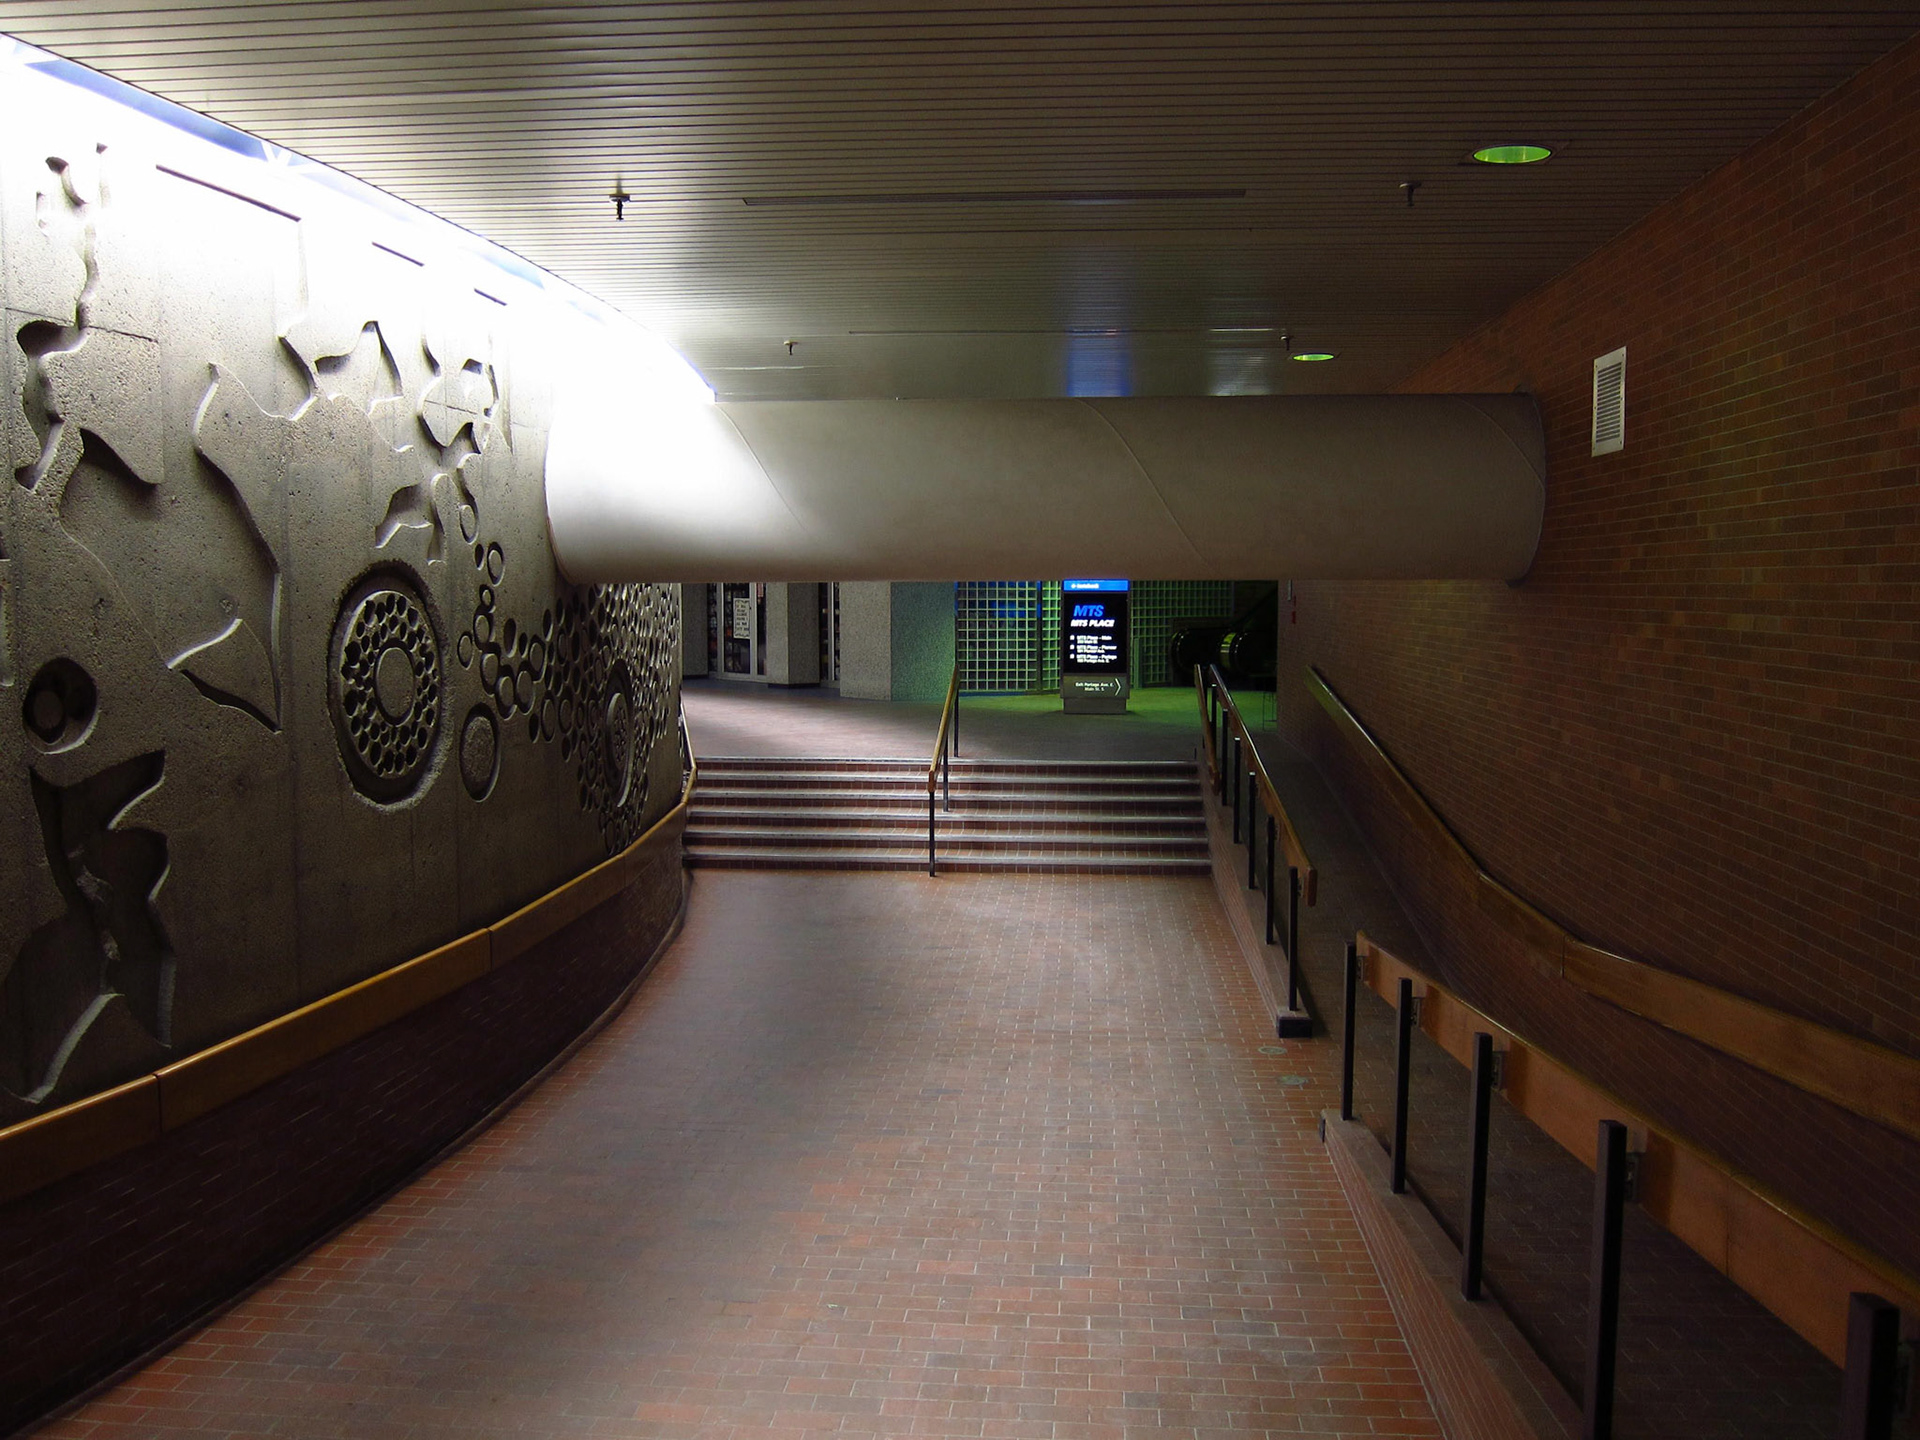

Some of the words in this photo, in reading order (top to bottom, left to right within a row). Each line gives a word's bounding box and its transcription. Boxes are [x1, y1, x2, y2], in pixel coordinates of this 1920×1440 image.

[1074, 605, 1105, 617] MTS
[1070, 619, 1089, 627] MTS
[1089, 619, 1115, 627] PLACE
